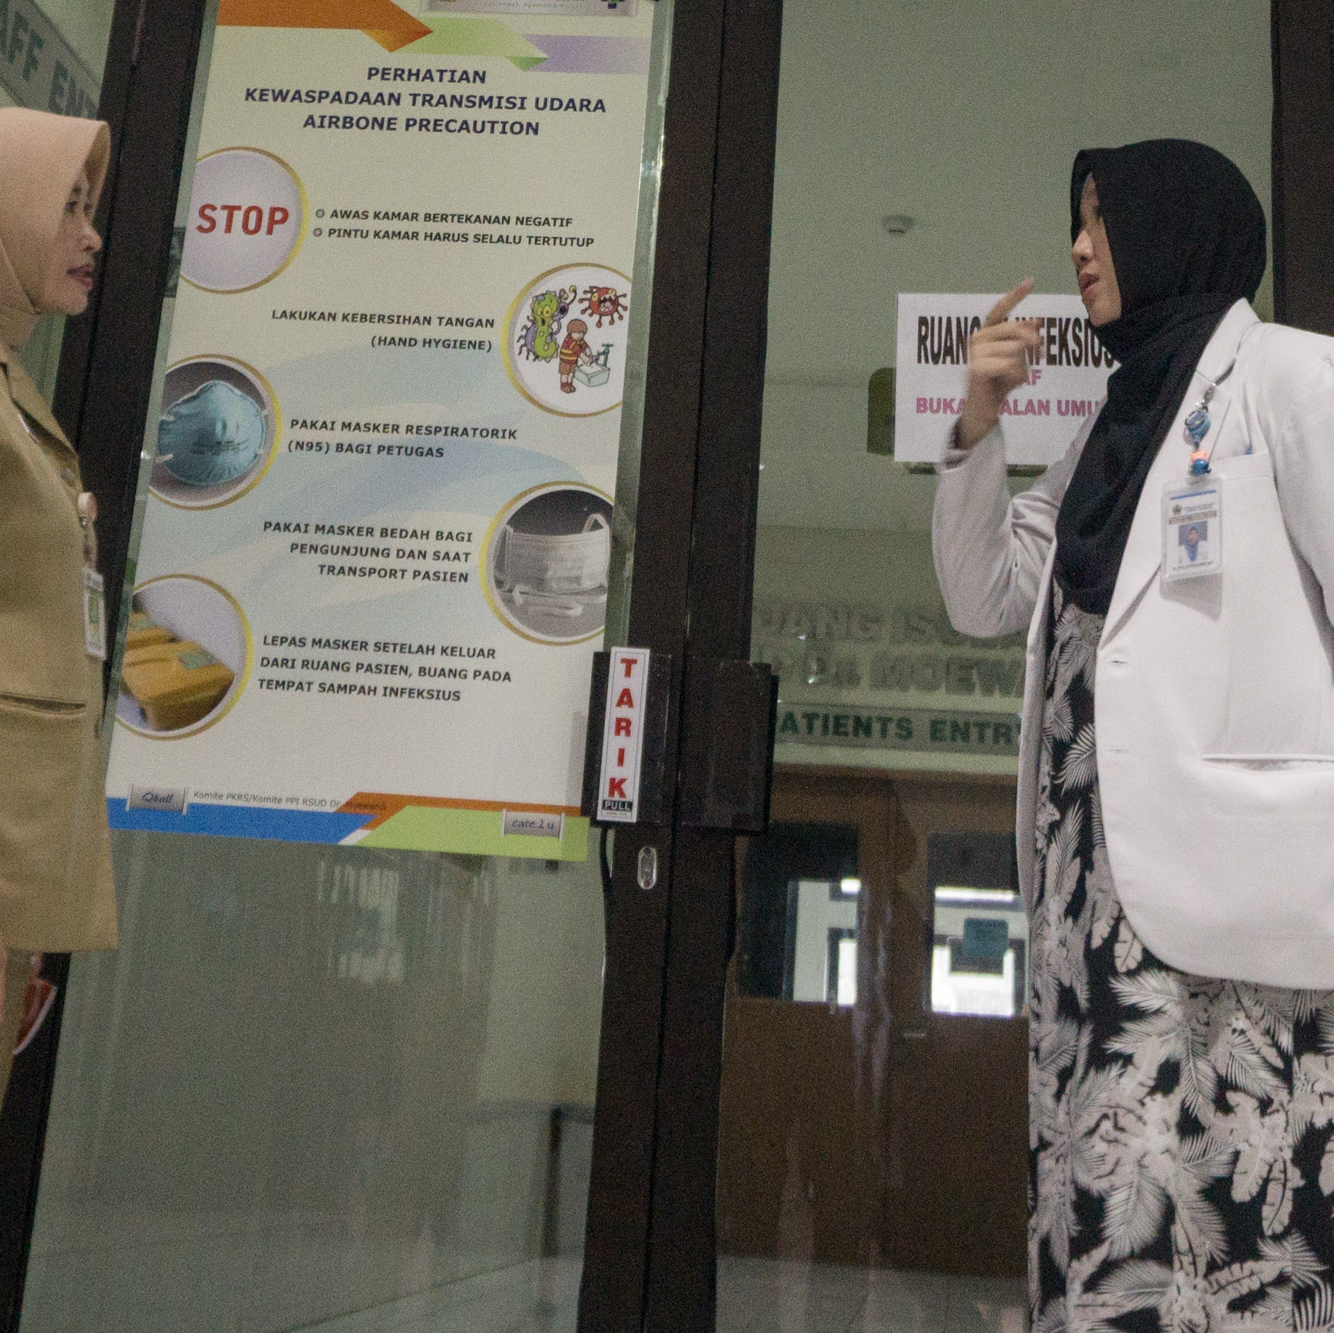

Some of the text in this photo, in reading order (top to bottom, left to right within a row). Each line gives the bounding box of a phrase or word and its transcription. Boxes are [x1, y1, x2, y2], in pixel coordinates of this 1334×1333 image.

[367, 67, 487, 84] PERHATIAN
[245, 87, 606, 113] KEWASPADAAN TRANSMISI UDARA
[303, 114, 540, 136] AIRBONE PRECAUTION
[196, 203, 290, 236] STOP
[330, 209, 573, 228] AWAS KAMAR BERTEKANAN NEGATIF
[328, 228, 595, 248] PINTU KAMAR HARUS SELALU TERTUTUP
[272, 309, 496, 329] LAKUKAN KEBERSIHAN TANGAN
[370, 334, 493, 353] (HAND HYGIENE)
[290, 418, 518, 440] PAKAI MASKER RESPIRATORIK
[287, 439, 445, 458] (N95) BAGI PETUGAS
[263, 520, 473, 543] PAKAI MASKER BEDAH BAGI
[289, 542, 472, 562] PENGUNJUNG DAN SAAT
[318, 564, 469, 583] TRANSPORT PASIEN
[262, 634, 497, 659] LEPAS MASKER SETELAH KELUAR
[260, 656, 512, 683] DARI RUANG PASIEN, BUANG PADA
[257, 679, 462, 702] TEMPAT SAMPAH INFEKSIUS
[608, 658, 638, 799] TARIK
[777, 711, 1023, 745] ATIENTS ENTR
[194, 791, 224, 801] Komite
[285, 797, 300, 805] PPI
[302, 798, 328, 808] RSUD
[604, 800, 631, 811] PULL
